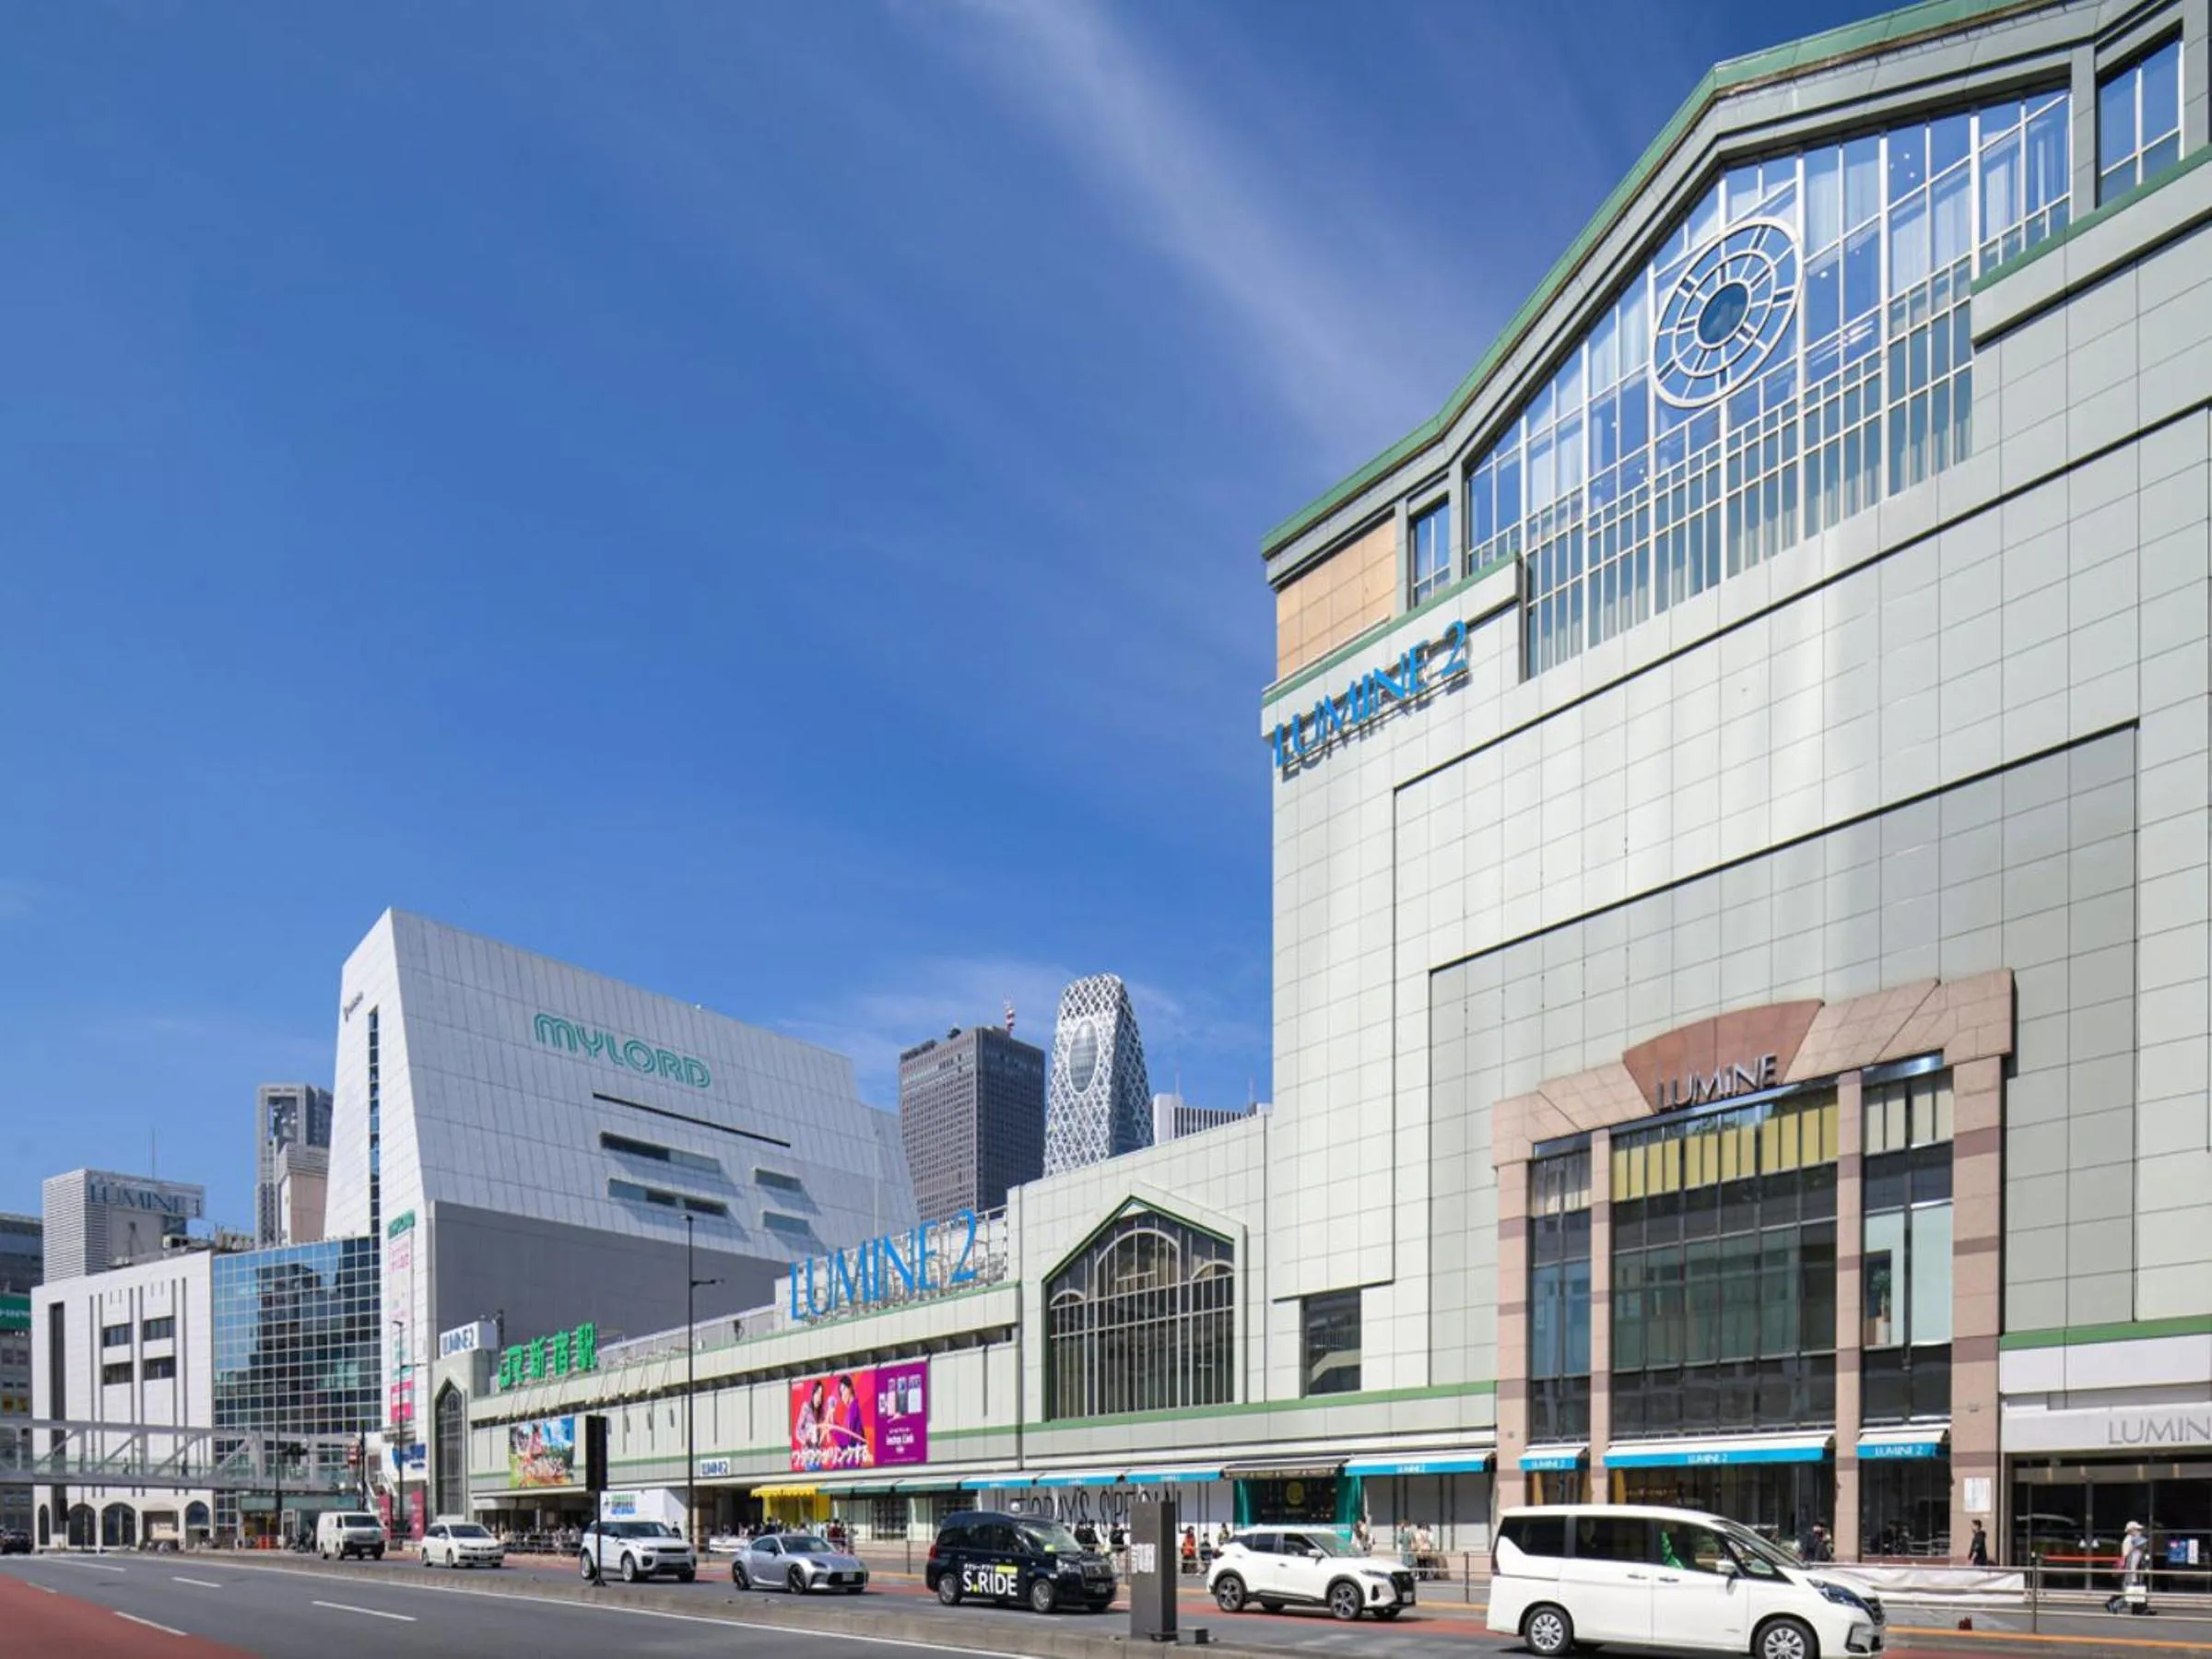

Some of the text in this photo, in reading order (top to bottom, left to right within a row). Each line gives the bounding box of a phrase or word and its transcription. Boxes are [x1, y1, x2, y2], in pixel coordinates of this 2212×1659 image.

[1275, 619, 1469, 768] LUMINE 2
[534, 1013, 711, 1088] MYLORD
[1655, 1053, 1778, 1112] LUMINE
[789, 1208, 978, 1321] LUMINE 2
[1875, 1445, 1924, 1456] LUMINE 2
[962, 1570, 1018, 1596] S.RIDE
